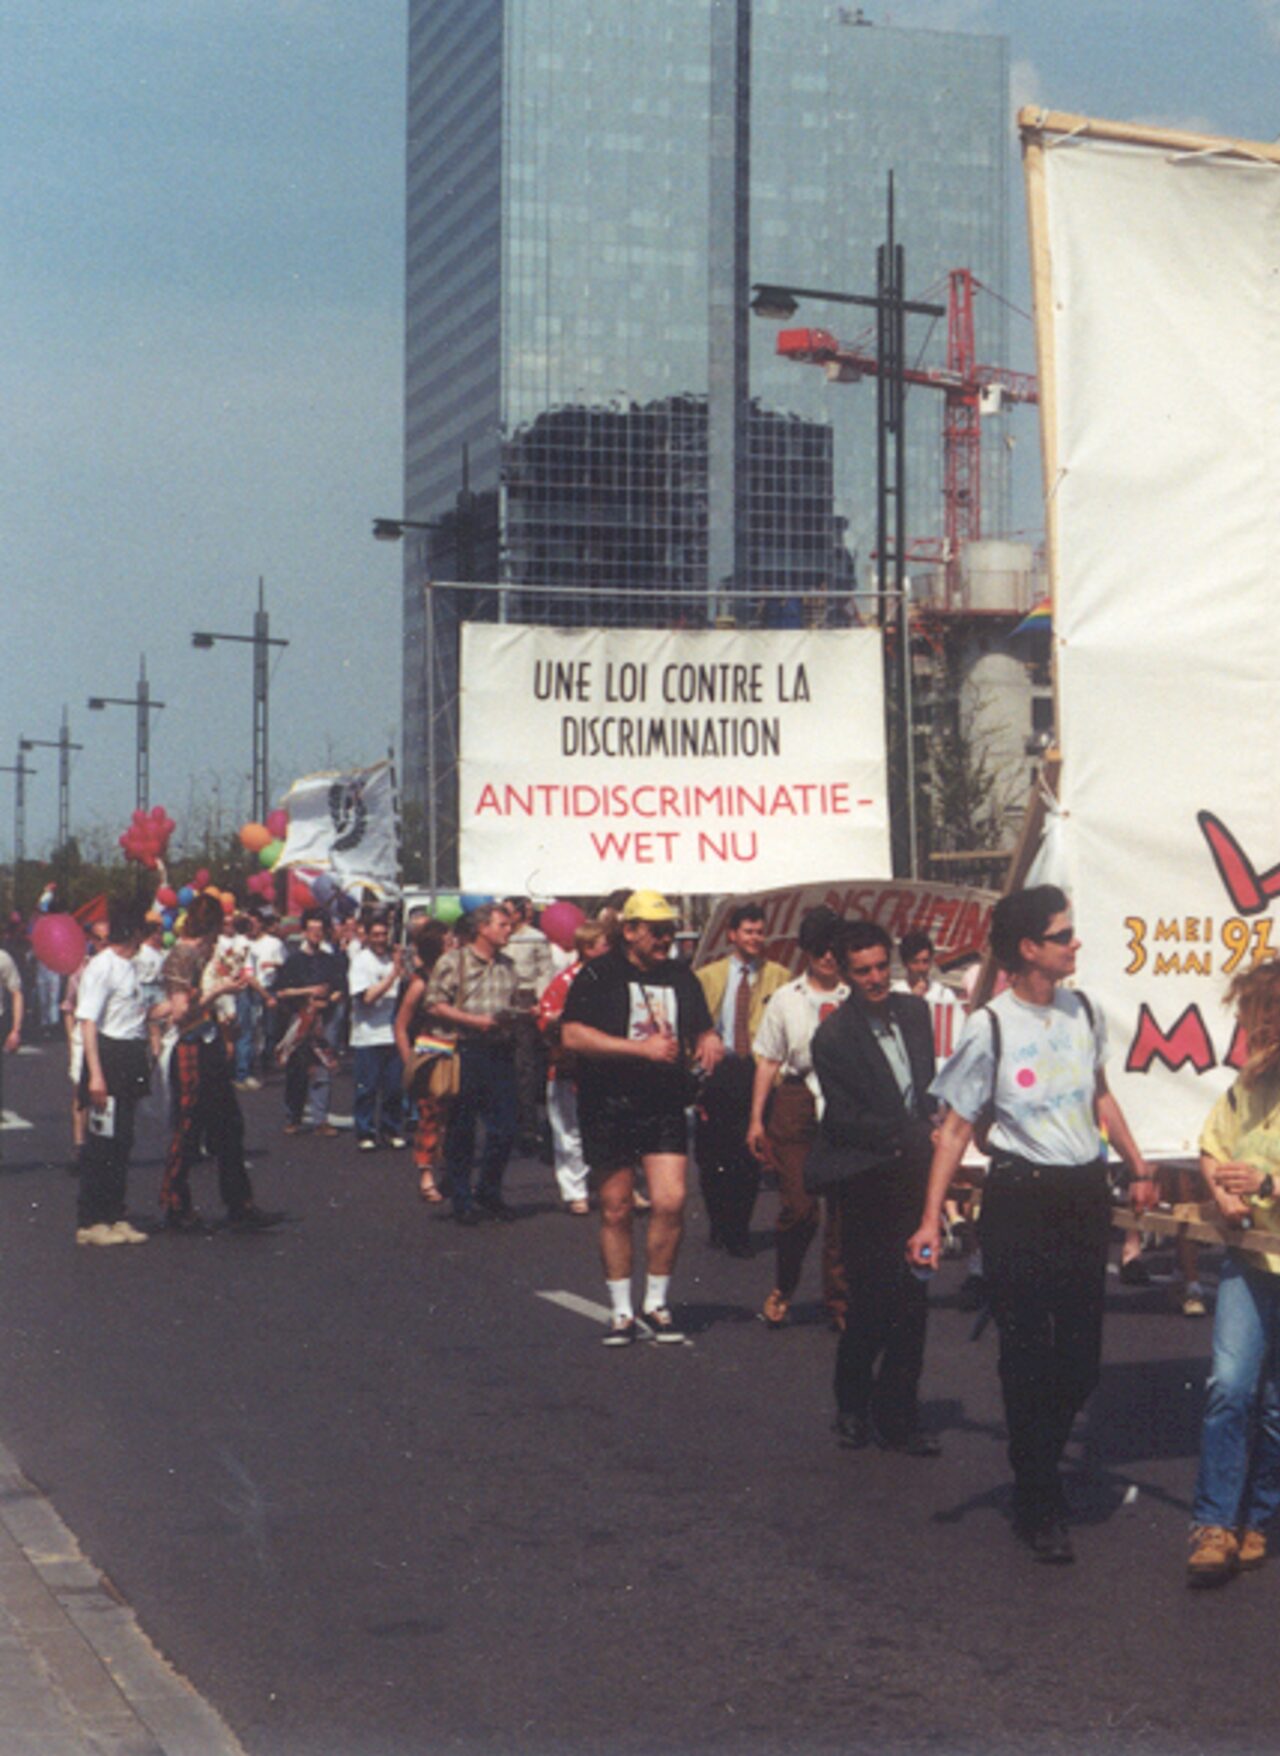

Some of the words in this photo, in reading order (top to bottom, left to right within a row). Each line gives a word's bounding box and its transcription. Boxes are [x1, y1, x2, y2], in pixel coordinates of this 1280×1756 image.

[533, 660, 591, 702] UNE
[606, 662, 647, 702] LOI
[662, 663, 763, 702] CONTRE
[778, 663, 811, 702] LA
[562, 716, 781, 757] DISCRIMINATION
[475, 783, 874, 817] ANTIDISCRIMINATIE-
[590, 832, 680, 863] WET
[699, 831, 759, 862] NU
[1124, 916, 1147, 975] 3
[1153, 917, 1213, 942] MEI
[1153, 951, 1211, 975] MAI
